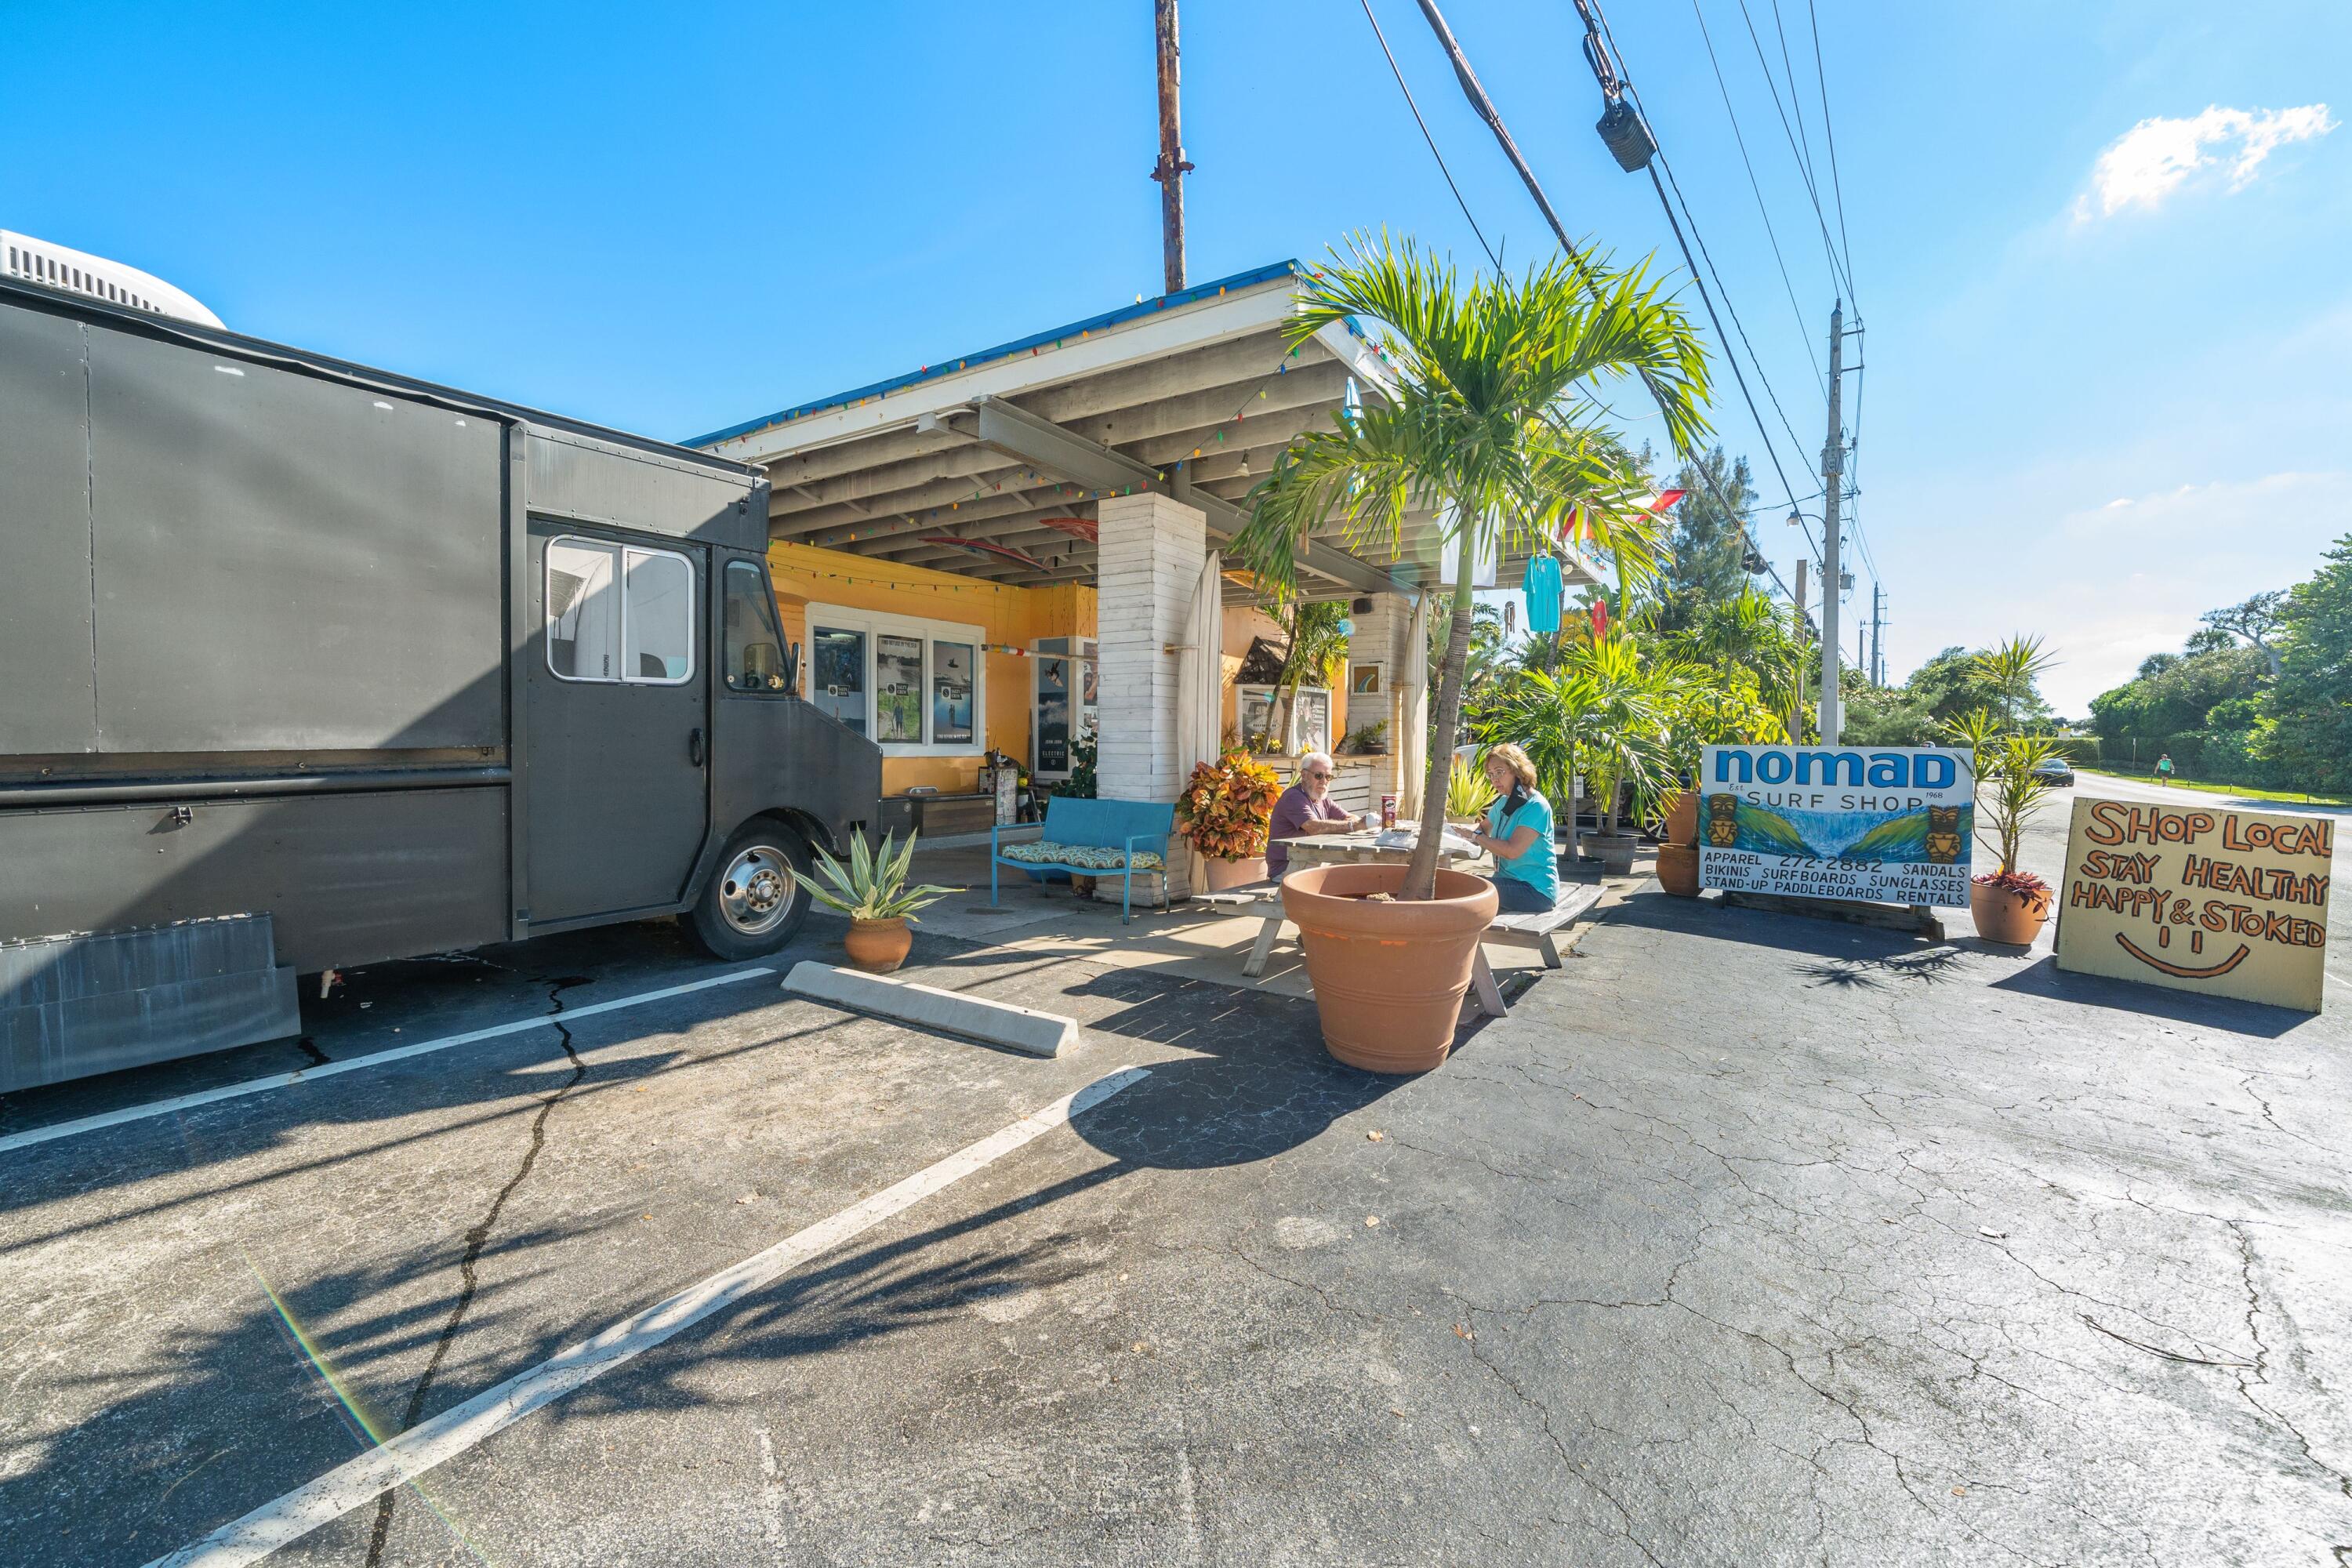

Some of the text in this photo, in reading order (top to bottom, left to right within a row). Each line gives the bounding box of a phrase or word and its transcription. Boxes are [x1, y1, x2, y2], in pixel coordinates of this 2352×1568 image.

[1747, 791, 1923, 811] SURF SHOP
[2085, 801, 2332, 858] SHOP LOCAL
[1704, 852, 1762, 866] APPAREL
[1780, 853, 1882, 873] 272-2882
[1902, 863, 1966, 878] SANDALS
[1704, 877, 1964, 906] STAND-UP PADDLEBOARDS RENTALS
[1705, 865, 1964, 892] BIKINIS SURFBOARDS SUNGLASSES
[2080, 850, 2330, 906] STAY HEALTHY
[2071, 880, 2326, 948] HAPPY & STOKED
